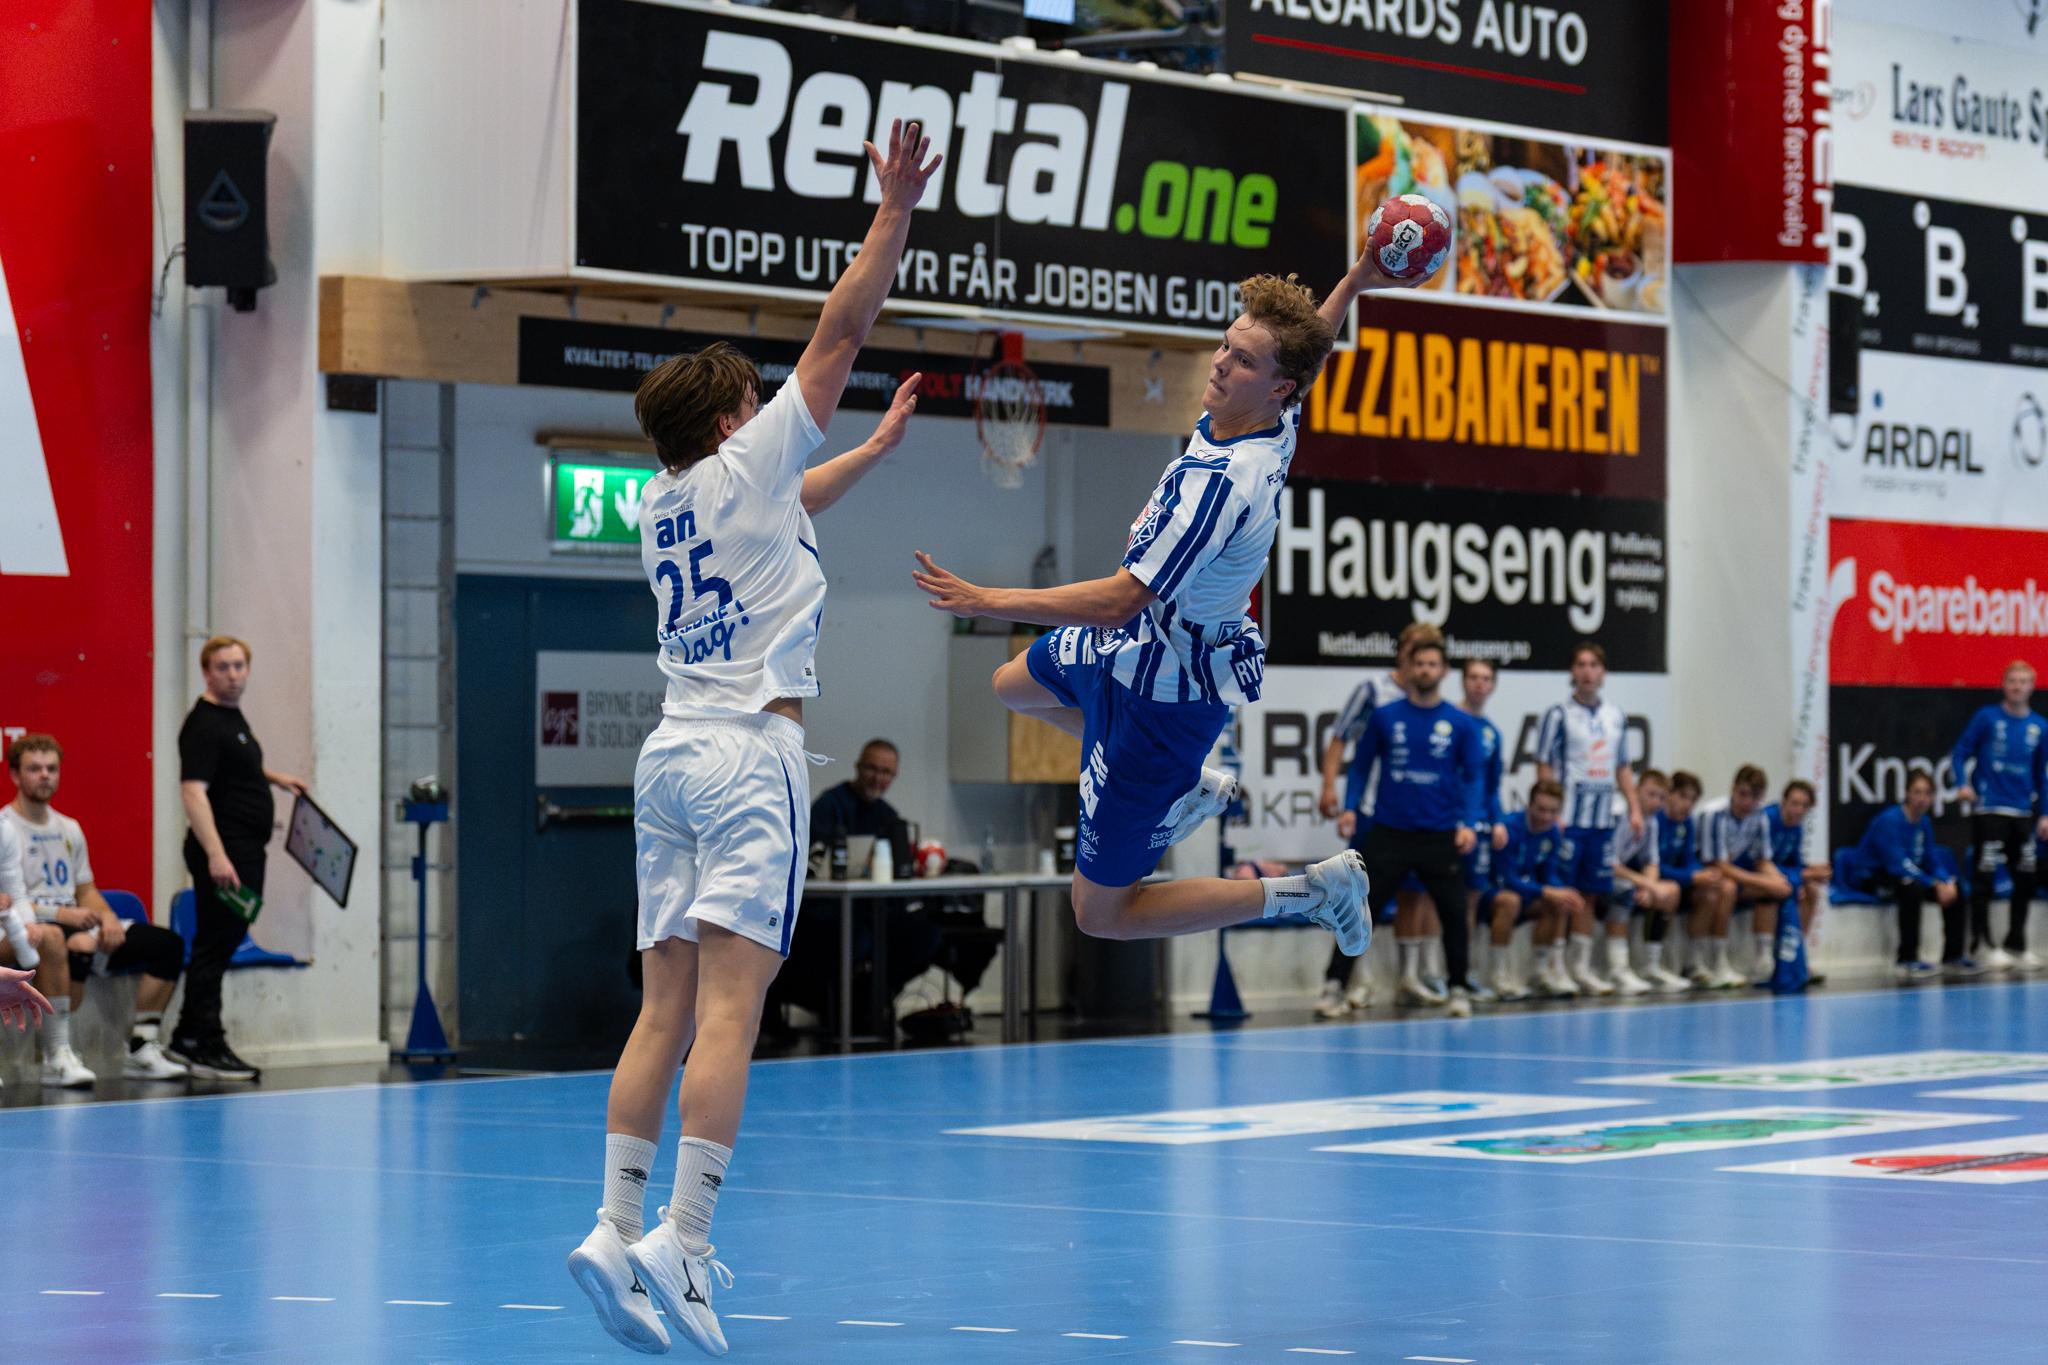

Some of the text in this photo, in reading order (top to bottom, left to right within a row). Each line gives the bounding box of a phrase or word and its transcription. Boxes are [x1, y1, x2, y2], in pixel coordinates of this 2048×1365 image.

[1472, 0, 1588, 66] AUTO
[1891, 62, 1944, 129] Lars
[1951, 72, 2022, 142] Gaute
[681, 222, 786, 278] TOPP
[949, 242, 1017, 302] FÅR
[1024, 261, 1159, 316] JOBBEN
[1384, 224, 1417, 268] SELECT
[1310, 326, 1641, 456] IZZABAKEREN
[1863, 420, 1985, 475] ARDAL
[655, 510, 697, 549] an
[1276, 486, 1606, 635] Haugseng
[656, 539, 733, 634] 25
[1868, 570, 2048, 645] Sparebank
[42, 860, 69, 887] 10
